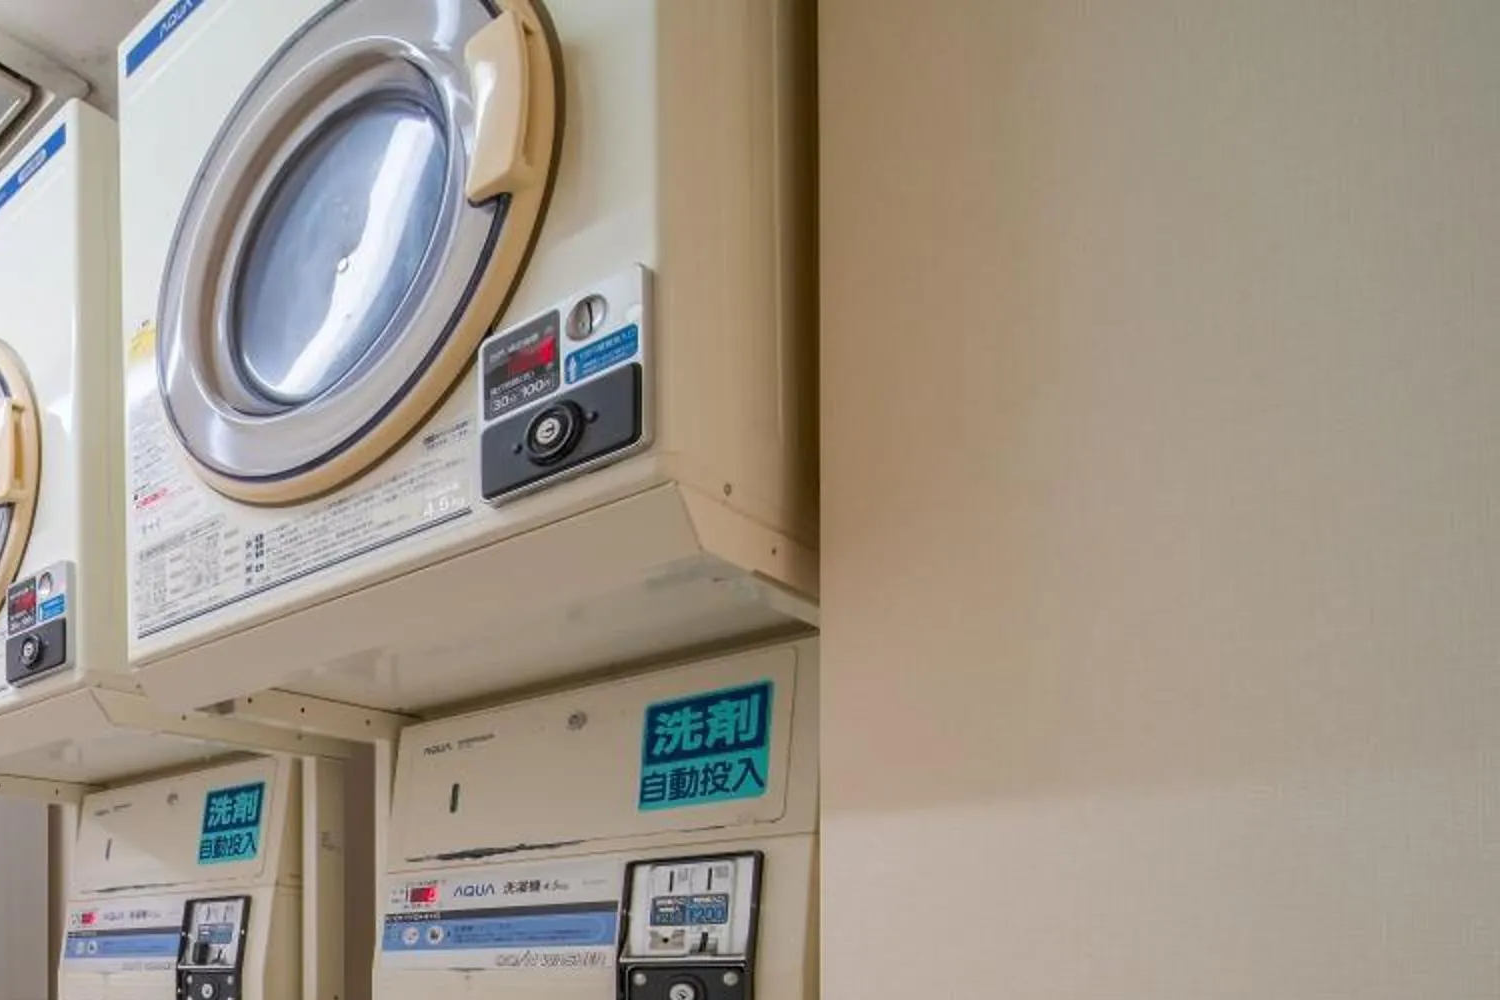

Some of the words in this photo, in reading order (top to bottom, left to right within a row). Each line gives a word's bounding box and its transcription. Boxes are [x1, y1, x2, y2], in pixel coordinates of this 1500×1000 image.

[654, 695, 760, 755] 洗剤
[641, 757, 766, 803] 自動投入
[207, 789, 261, 828] 洗剤
[200, 831, 257, 859] 自動投入
[453, 881, 495, 898] AQUA
